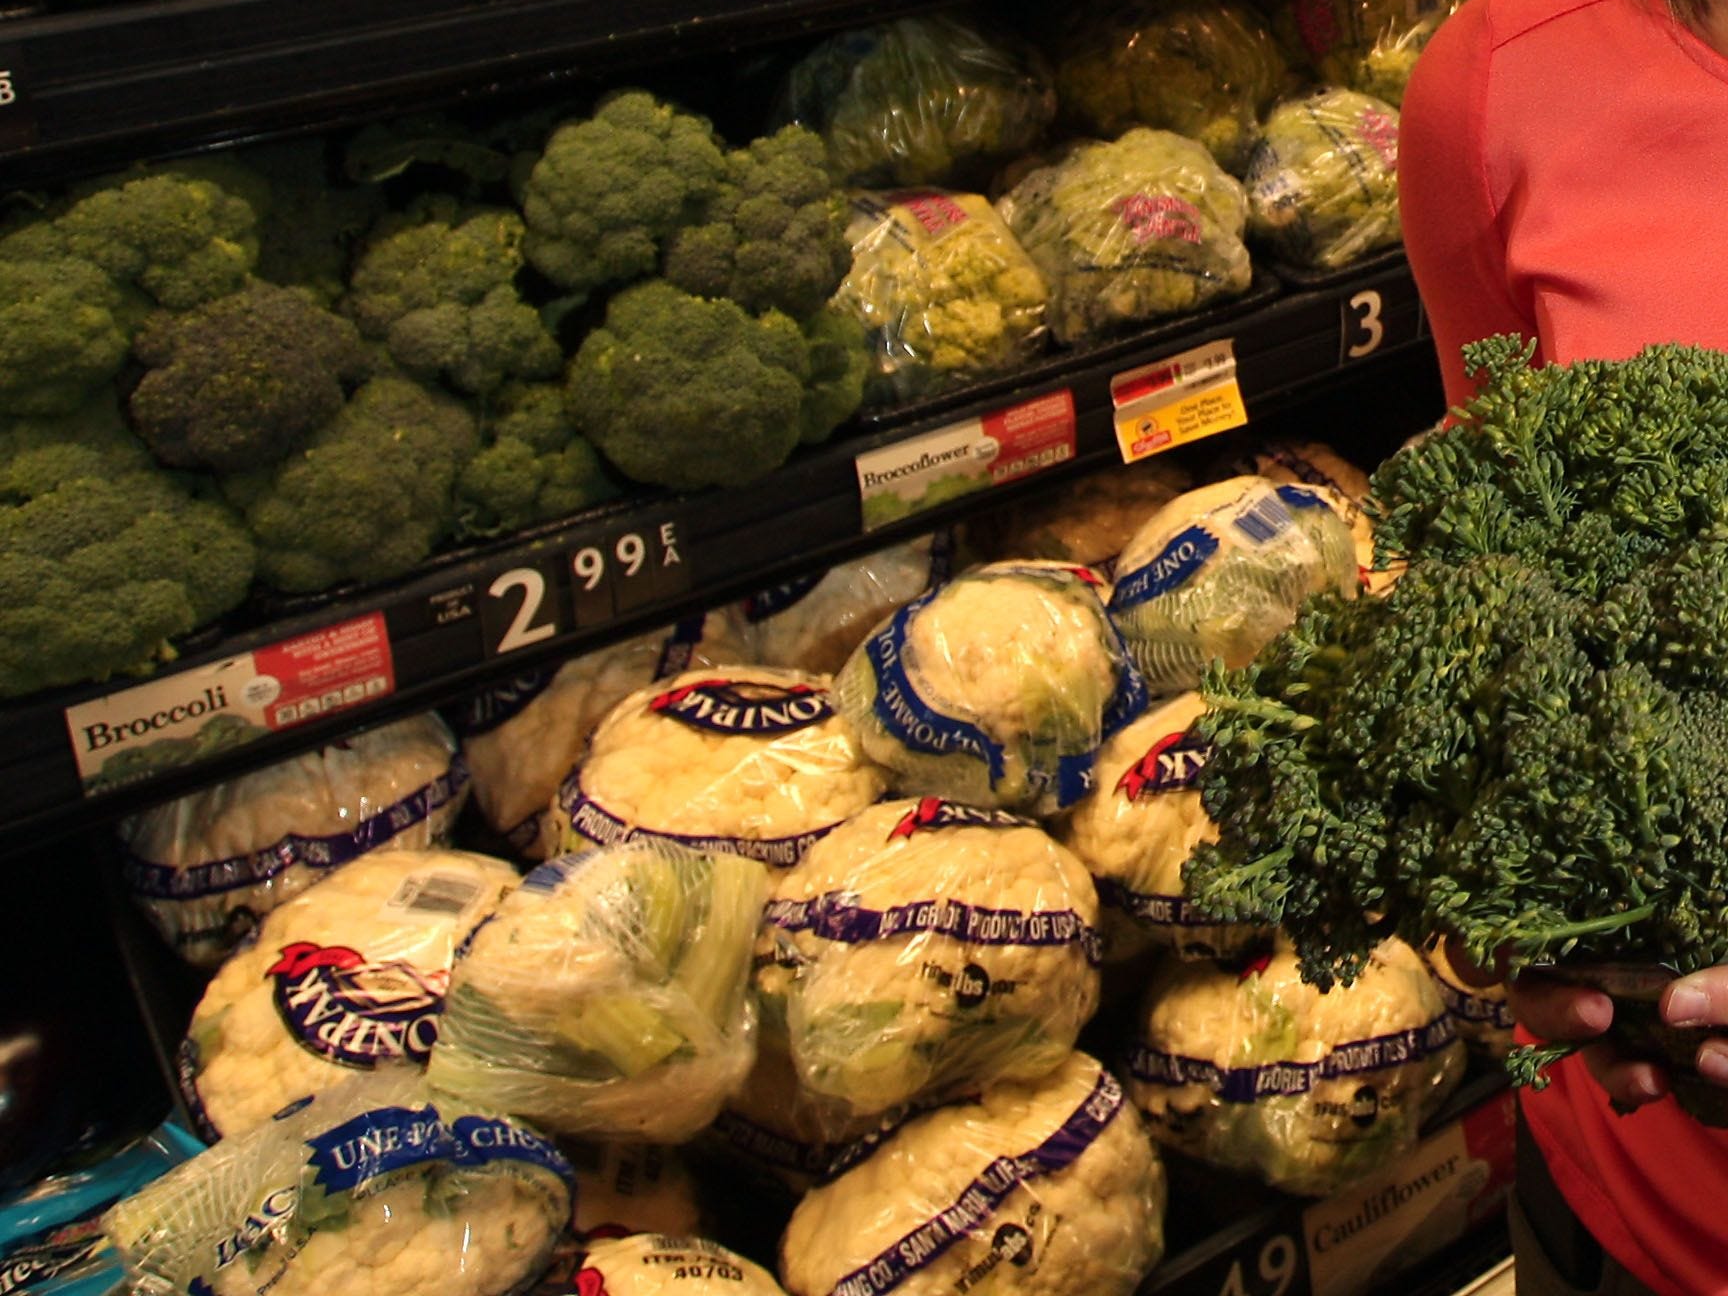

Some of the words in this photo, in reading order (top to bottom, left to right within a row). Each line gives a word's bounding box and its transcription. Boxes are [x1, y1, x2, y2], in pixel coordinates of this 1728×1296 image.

[1350, 290, 1383, 358] 3
[864, 443, 971, 489] Broccoflower
[1153, 540, 1196, 580] ONE
[84, 684, 229, 752] Broccoli
[968, 912, 1024, 938] PRODUCT
[1029, 916, 1050, 939] OF
[332, 1129, 400, 1171] UNE
[1314, 1155, 1459, 1253] Cauliflower
